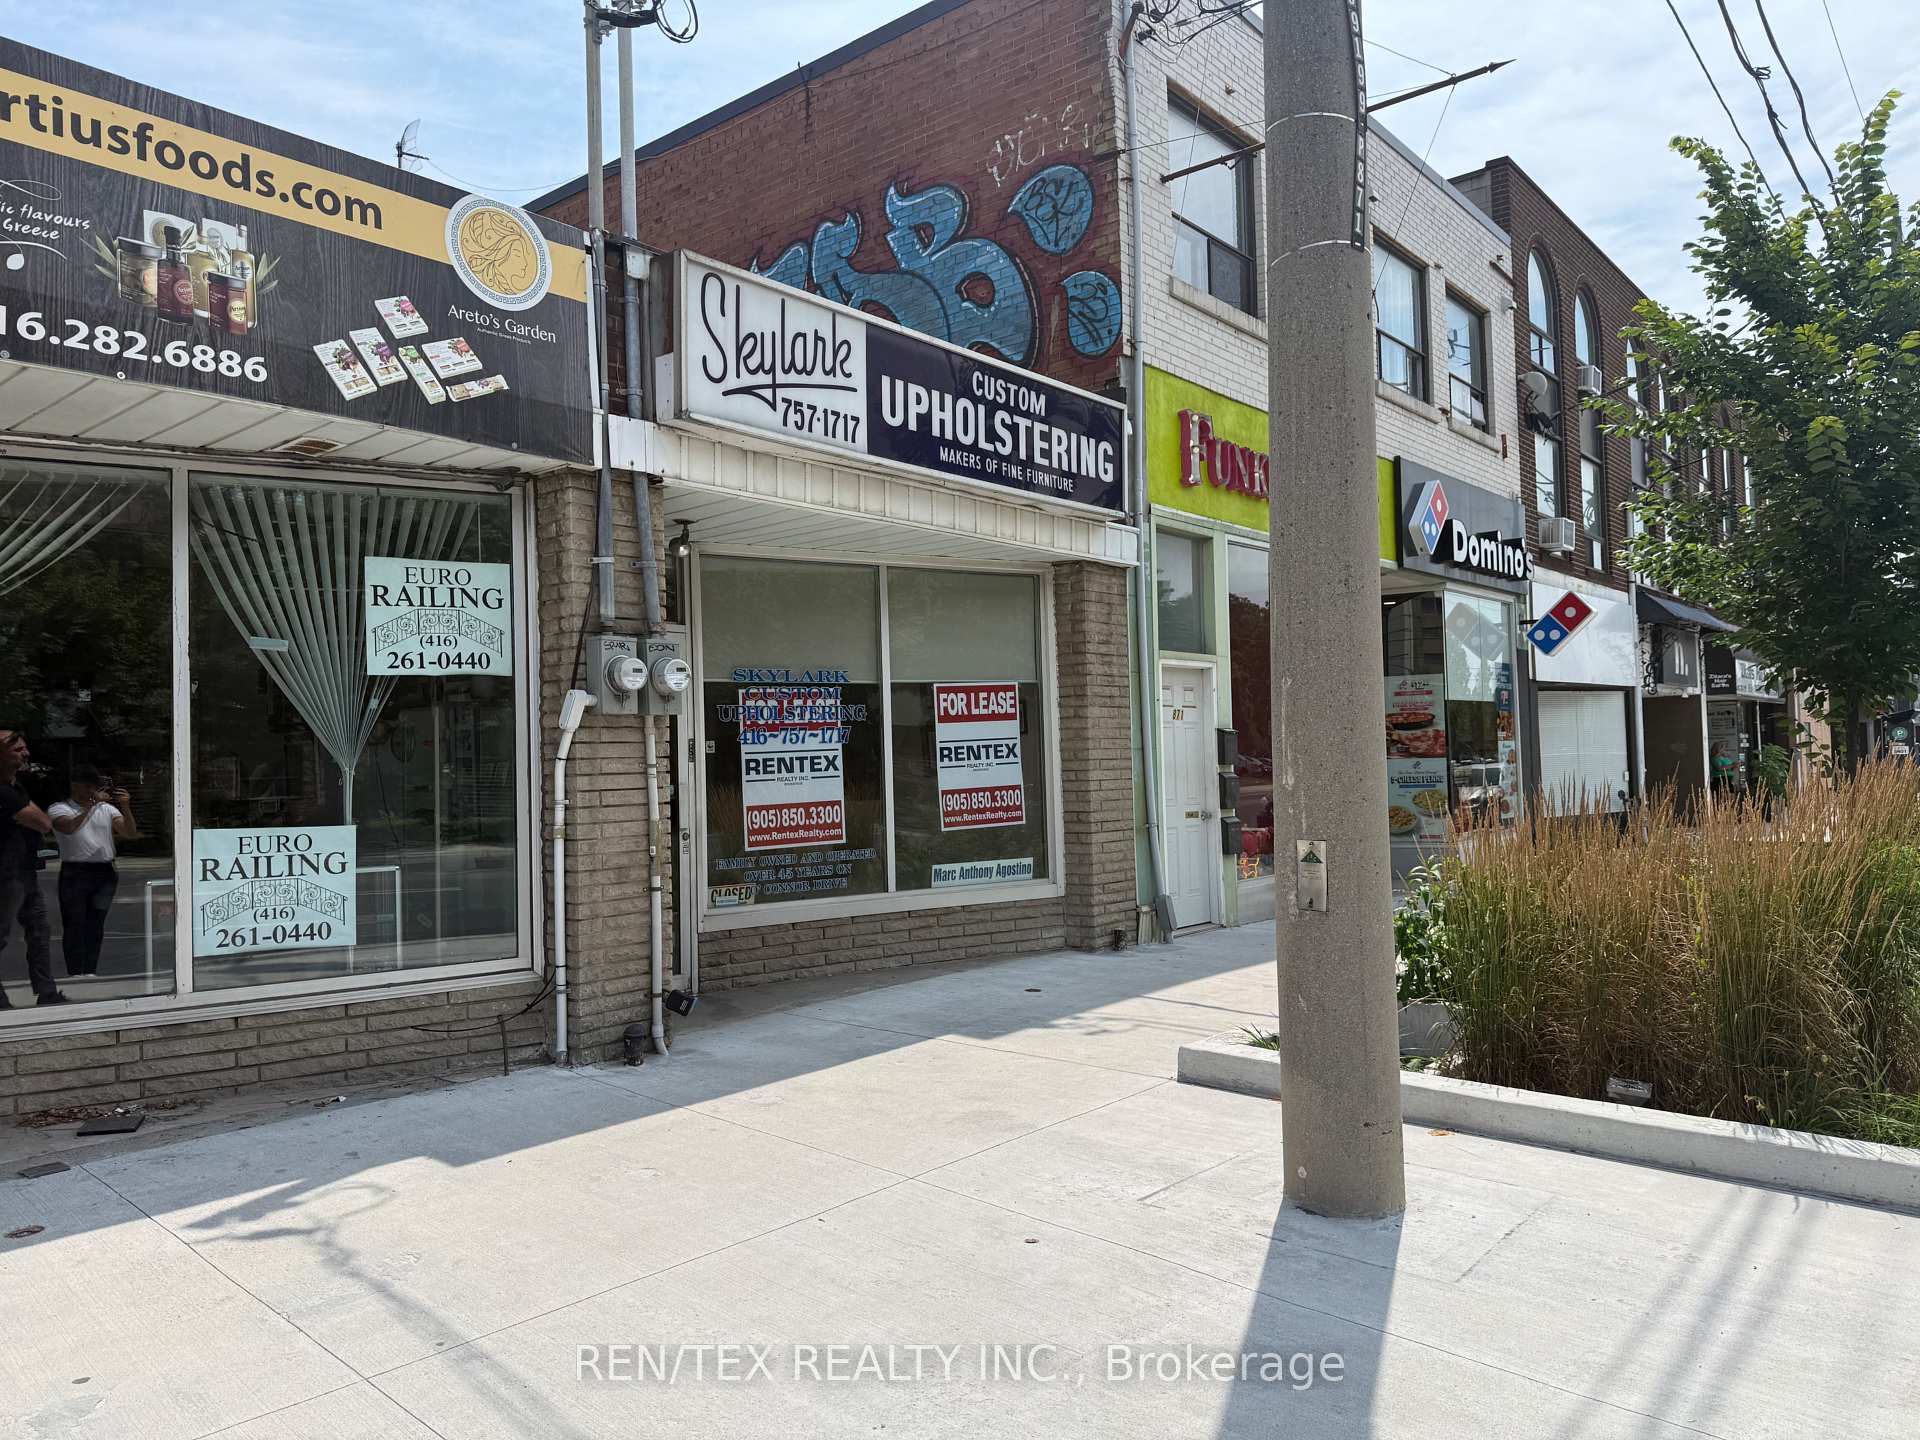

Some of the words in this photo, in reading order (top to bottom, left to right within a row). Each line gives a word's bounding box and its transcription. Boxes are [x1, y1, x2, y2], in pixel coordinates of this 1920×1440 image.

[0, 201, 15, 214] ic
[20, 204, 90, 230] flavours
[2, 218, 60, 240] Greece
[447, 304, 501, 329] Areto's
[505, 319, 556, 343] Garden
[0, 304, 268, 382] 16.282.6886
[701, 273, 856, 410] Skylark
[971, 370, 1047, 416] CUSTOM
[880, 374, 1115, 483] UPHOLSTERING
[939, 445, 982, 471] MAKERS
[985, 457, 999, 473] OF
[1002, 461, 1024, 481] FINE
[1026, 468, 1075, 494] FURNITURE
[1452, 518, 1535, 579] Domino's
[404, 567, 473, 586] EURO
[370, 584, 505, 610] RAILING
[419, 634, 459, 650] (416)
[386, 650, 491, 672] 261-0440
[732, 668, 850, 684] SKYLARK
[745, 686, 842, 701] CUSTOM
[939, 692, 967, 717] FOR
[971, 691, 1015, 716] LEASE
[717, 704, 867, 723] UPHOLSTERING
[939, 743, 1018, 763] RENTEX
[745, 755, 841, 777] RENTEX
[942, 788, 1022, 812] (905)850.3300
[747, 804, 842, 830] (905)850.3300
[944, 808, 1023, 825] www.RentexRealty.com
[238, 833, 313, 856] EURO
[748, 827, 842, 844] www.RentexRealty.com
[199, 851, 349, 882] RAILING
[759, 854, 798, 867] OWNED
[800, 852, 823, 864] AND
[744, 869, 775, 882] OVER
[797, 865, 833, 878] YEARS
[836, 863, 852, 875] ON
[933, 868, 956, 883] Marc
[958, 864, 993, 883] Anthony
[995, 861, 1033, 880] Agostino
[813, 878, 848, 890] DRIVE
[252, 905, 296, 922] (416)
[216, 921, 333, 949] 261-0440
